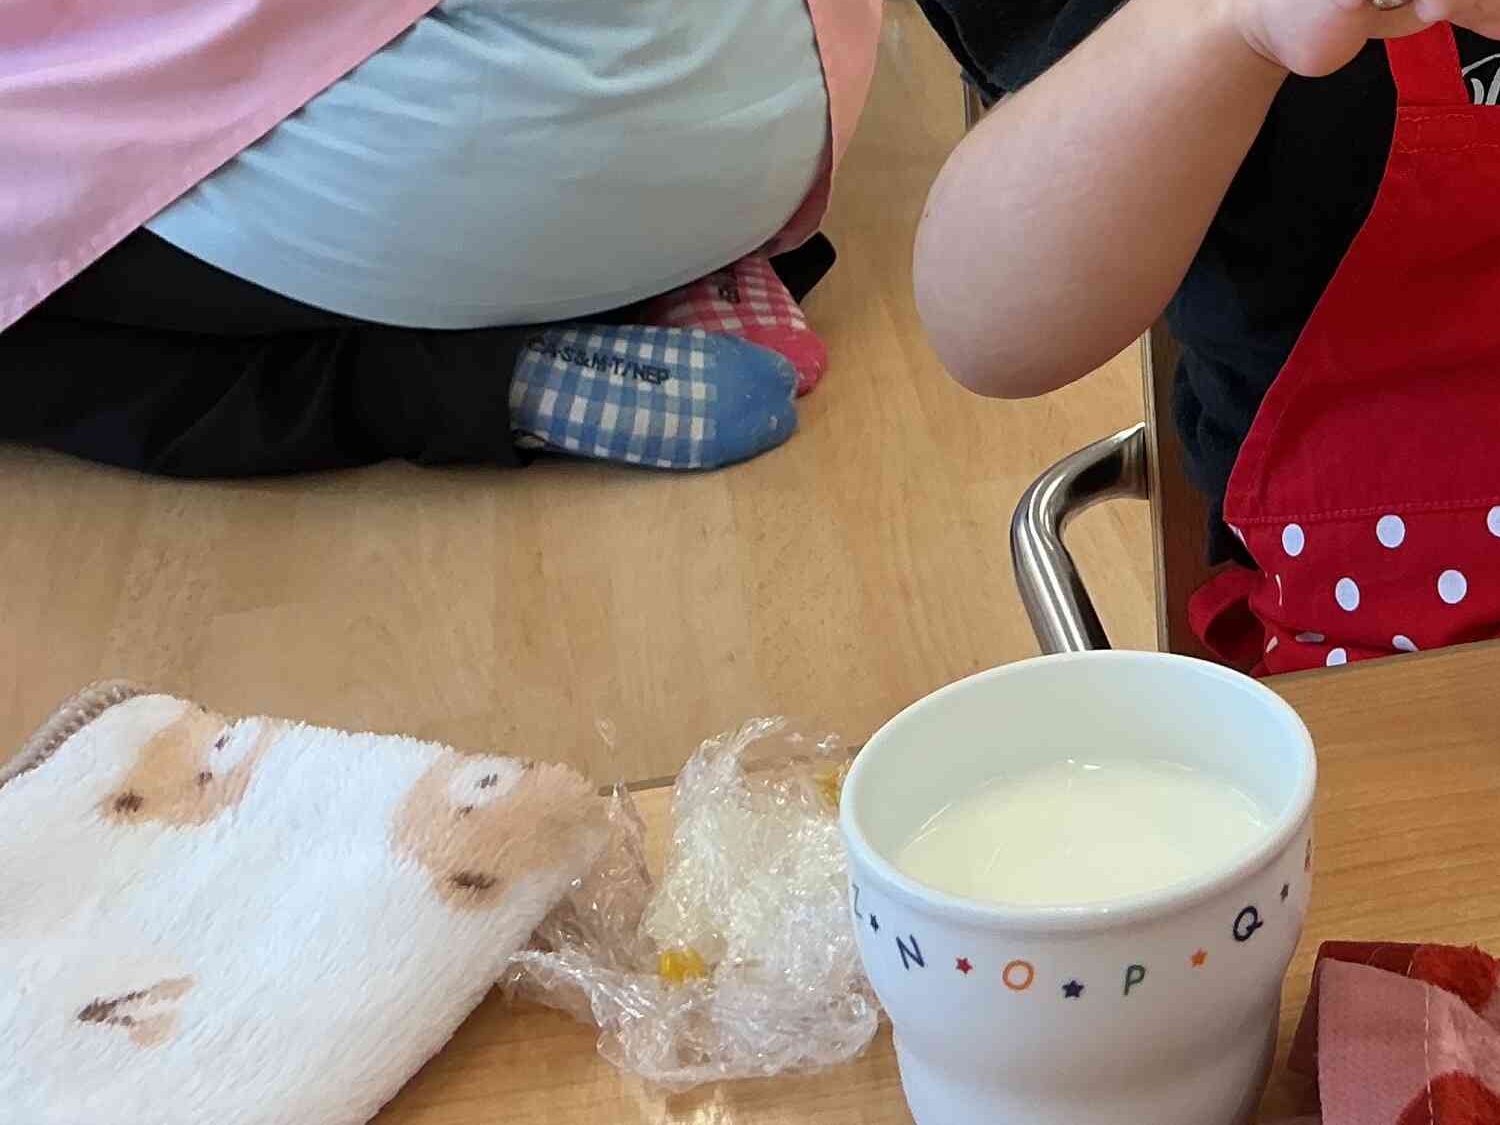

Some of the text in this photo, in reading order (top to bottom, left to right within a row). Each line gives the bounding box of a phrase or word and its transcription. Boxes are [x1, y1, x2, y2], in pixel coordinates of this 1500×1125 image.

[896, 935, 926, 971] N
[1002, 960, 1034, 991] O
[1123, 964, 1146, 996] P
[1232, 905, 1264, 942] Q
